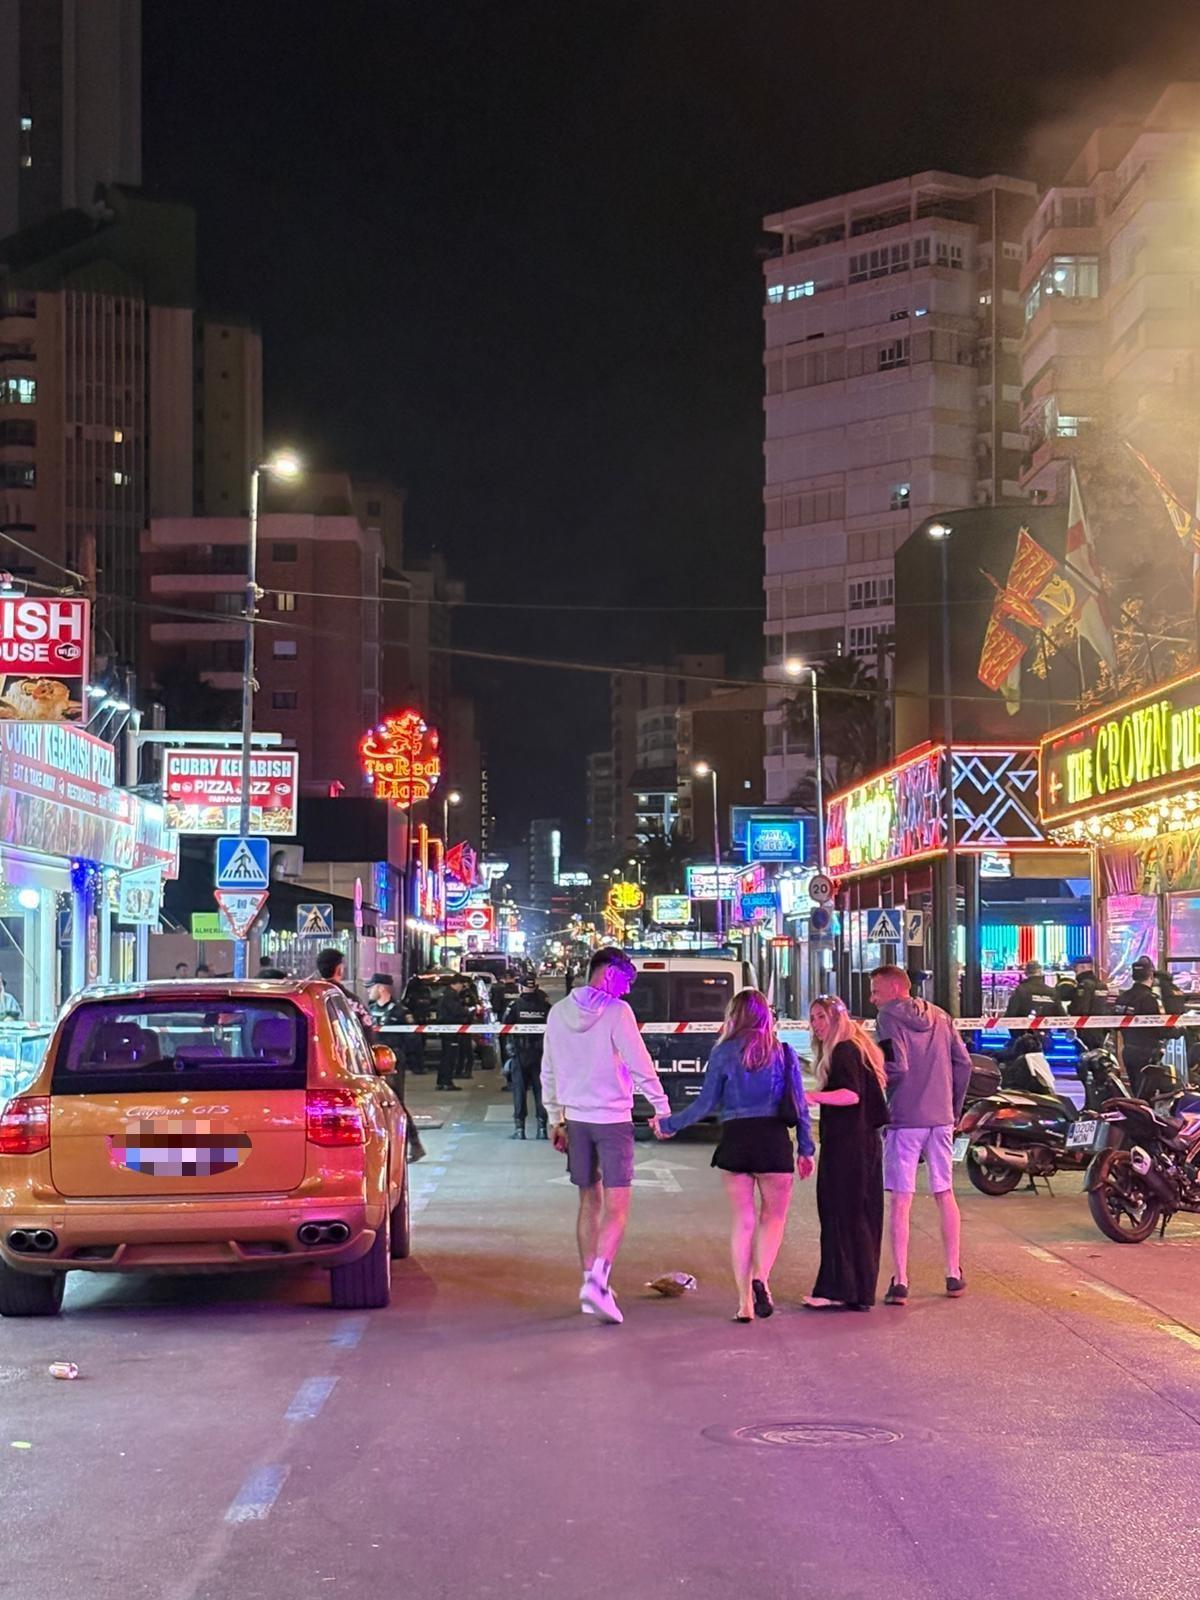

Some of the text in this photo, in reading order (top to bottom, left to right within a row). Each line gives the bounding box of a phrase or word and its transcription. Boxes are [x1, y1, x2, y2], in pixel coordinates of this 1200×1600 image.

[0, 602, 81, 640] ISH
[0, 643, 49, 662] USE
[1066, 749, 1093, 803] THE
[1096, 700, 1170, 794] CROWN
[170, 758, 291, 777] CURRY KEABISH
[394, 757, 440, 776] Red
[194, 780, 234, 794] PIZZA
[377, 780, 429, 799] Lion
[813, 884, 828, 894] 20
[655, 1056, 709, 1072] LICÍ
[126, 1105, 230, 1119] Cayenne GTS
